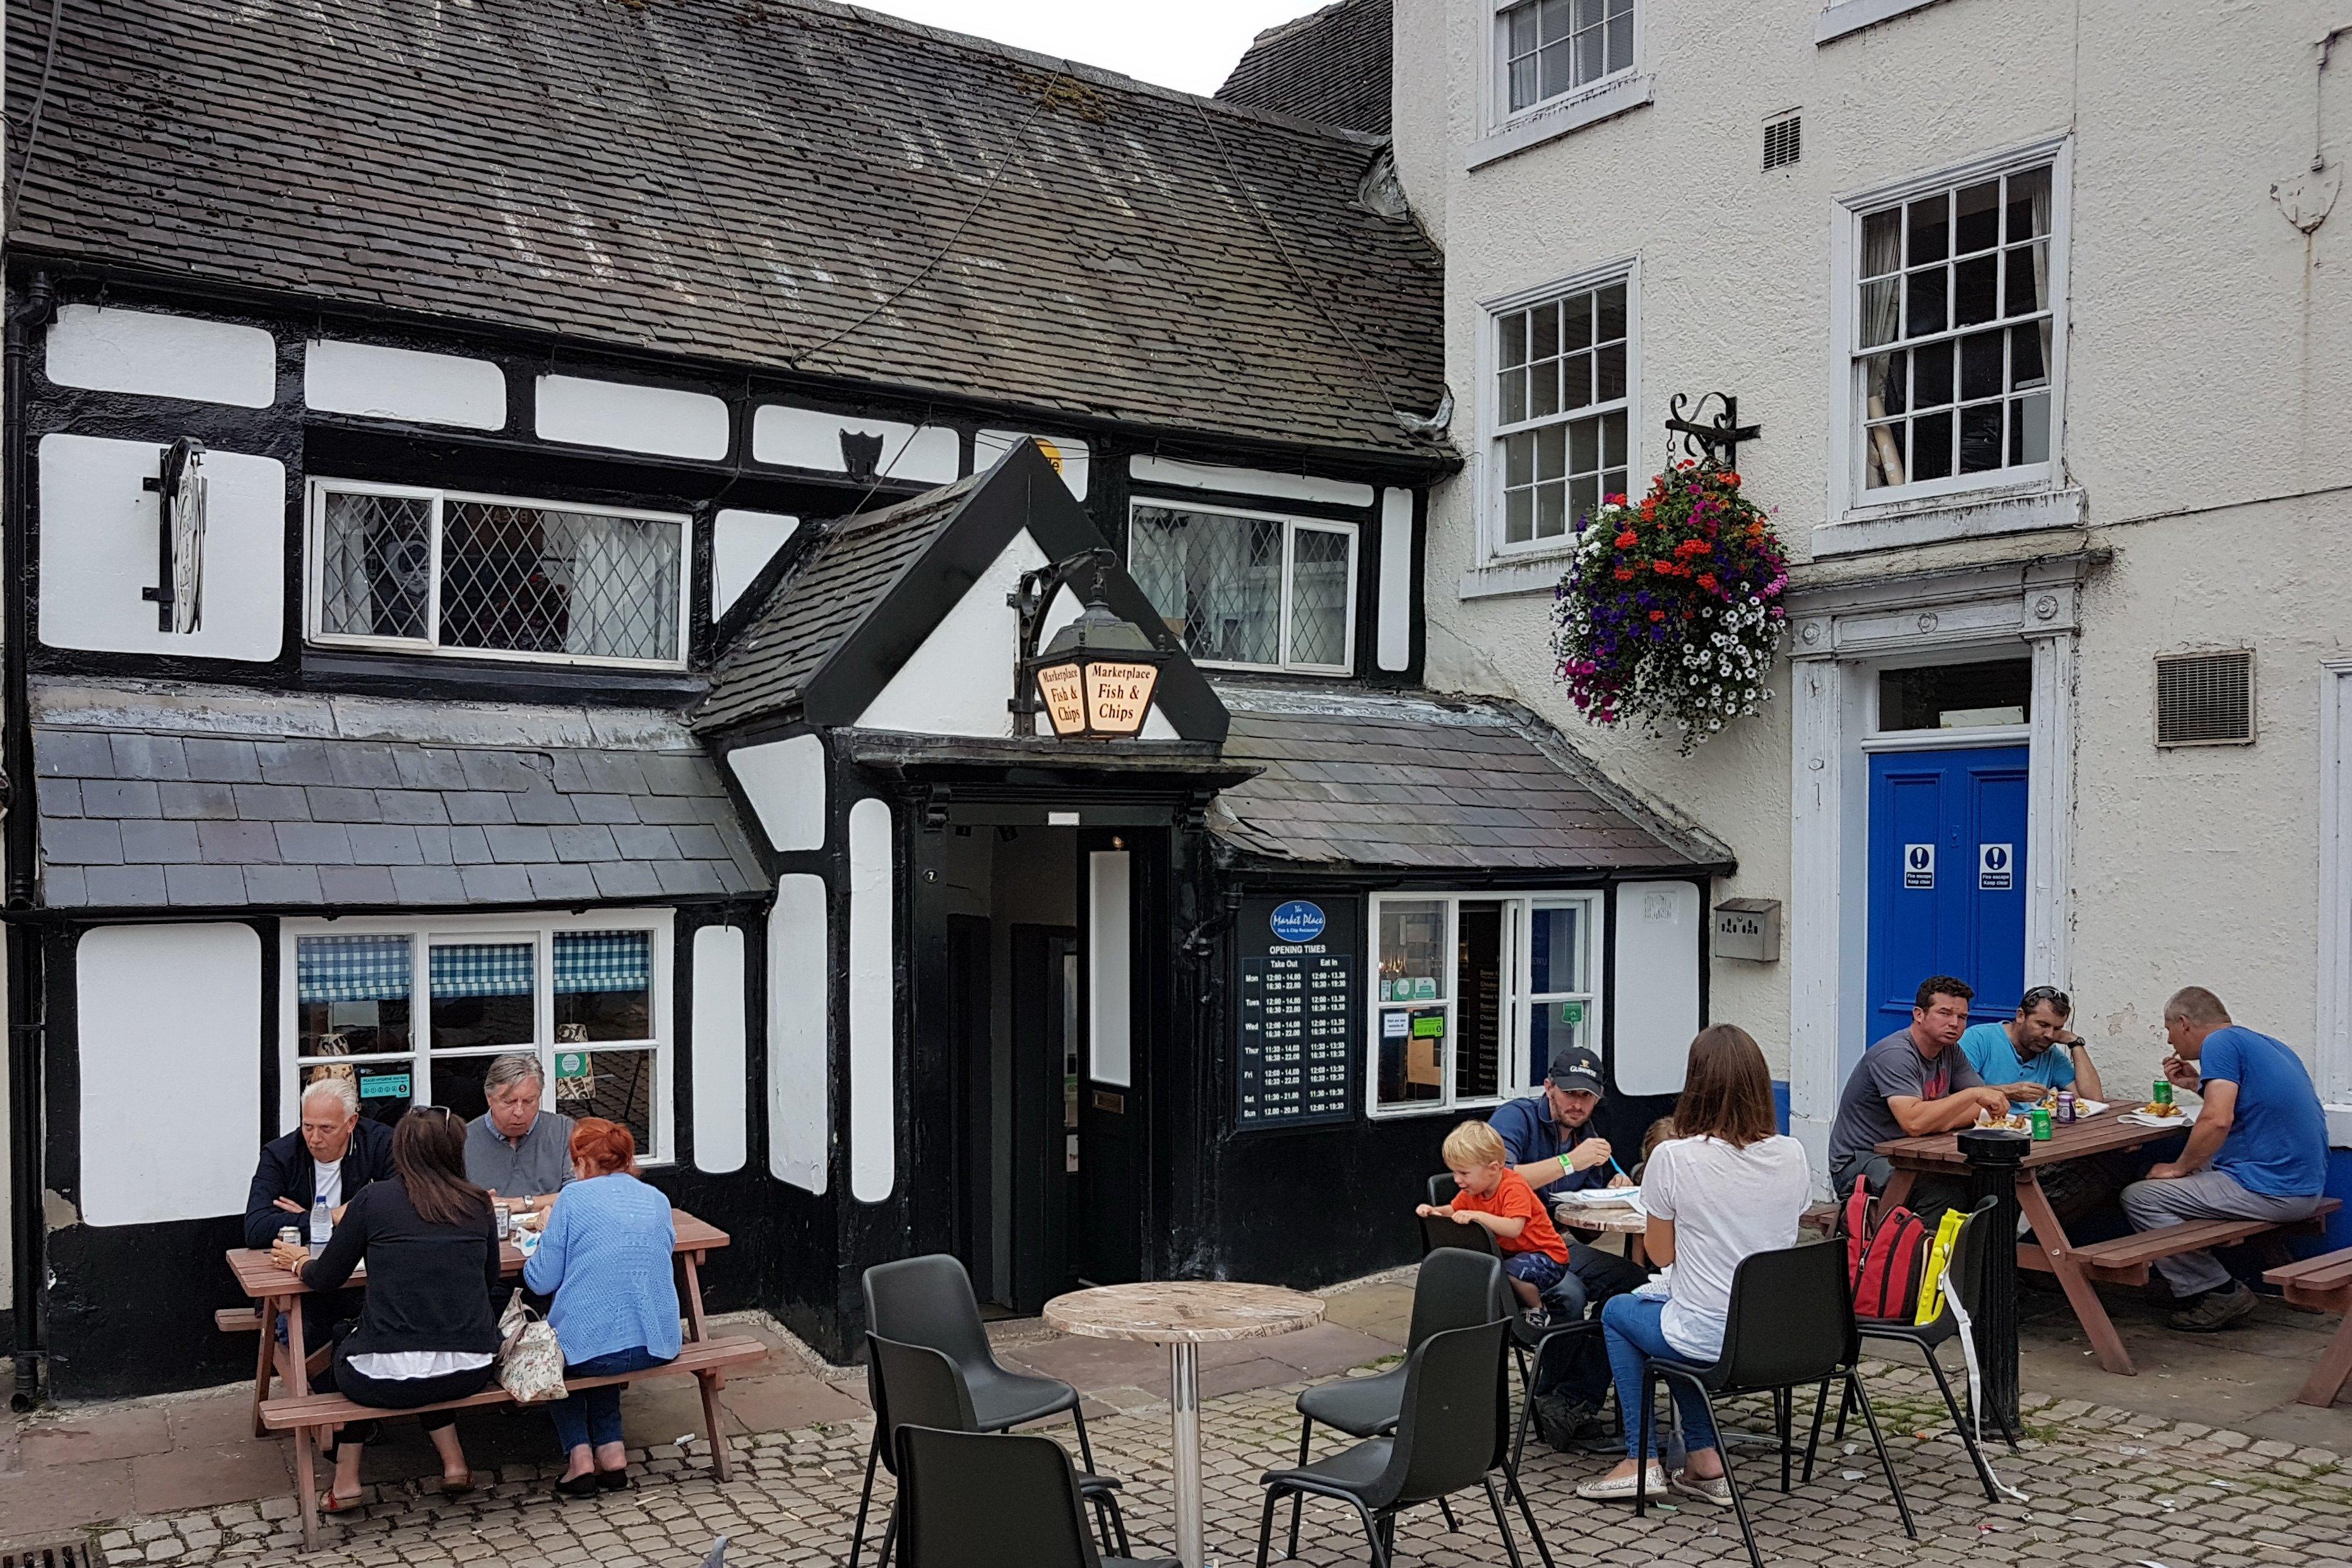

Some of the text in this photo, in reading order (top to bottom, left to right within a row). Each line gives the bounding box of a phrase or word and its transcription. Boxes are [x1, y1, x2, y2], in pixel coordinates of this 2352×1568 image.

[1042, 668, 1078, 683] Marketplace
[1092, 665, 1150, 680] Marketplace
[1051, 685, 1078, 703] Fish &
[1098, 683, 1139, 699] Fish &
[1058, 706, 1080, 723] Chips
[1099, 703, 1134, 722] Chips
[1273, 913, 1324, 926] Market Place
[1269, 945, 1326, 954] OPENING TIMES
